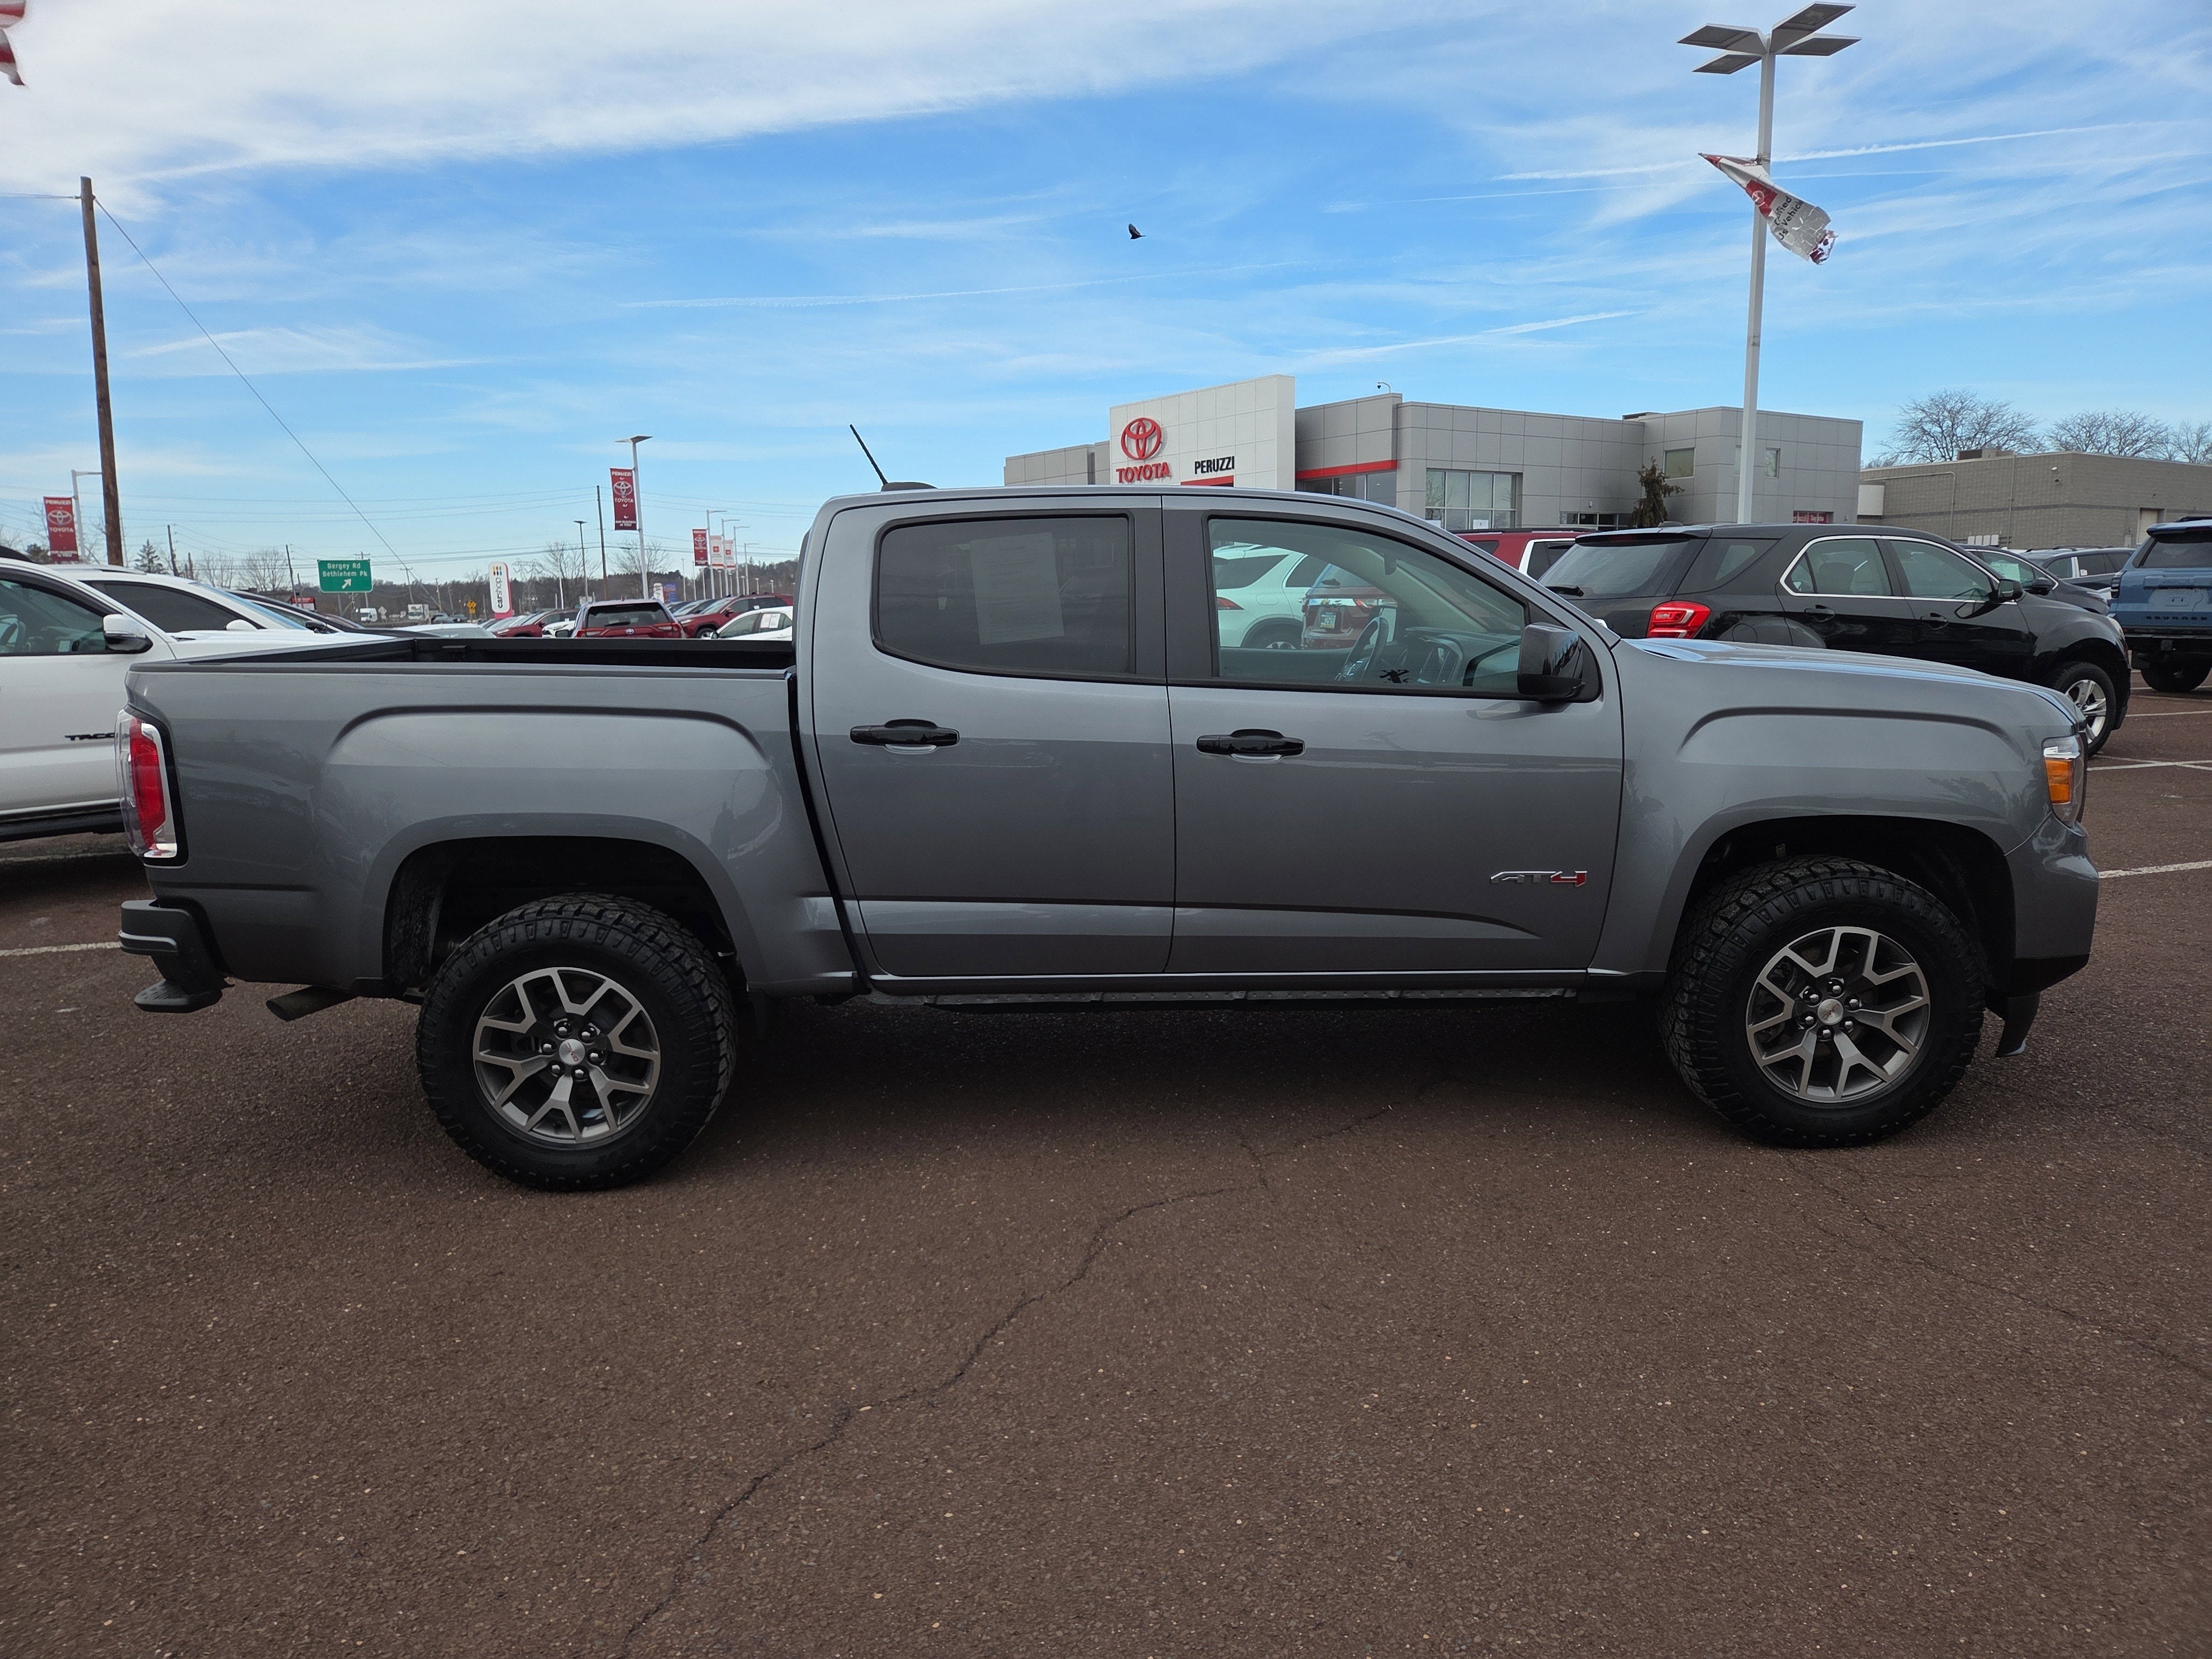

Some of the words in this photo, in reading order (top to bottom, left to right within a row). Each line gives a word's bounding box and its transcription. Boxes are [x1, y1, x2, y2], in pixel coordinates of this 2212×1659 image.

[1116, 462, 1171, 483] TOYOTA
[1194, 456, 1235, 474] PERUZZI
[1489, 871, 1587, 888] AT4
[1822, 1003, 1840, 1019] GMC
